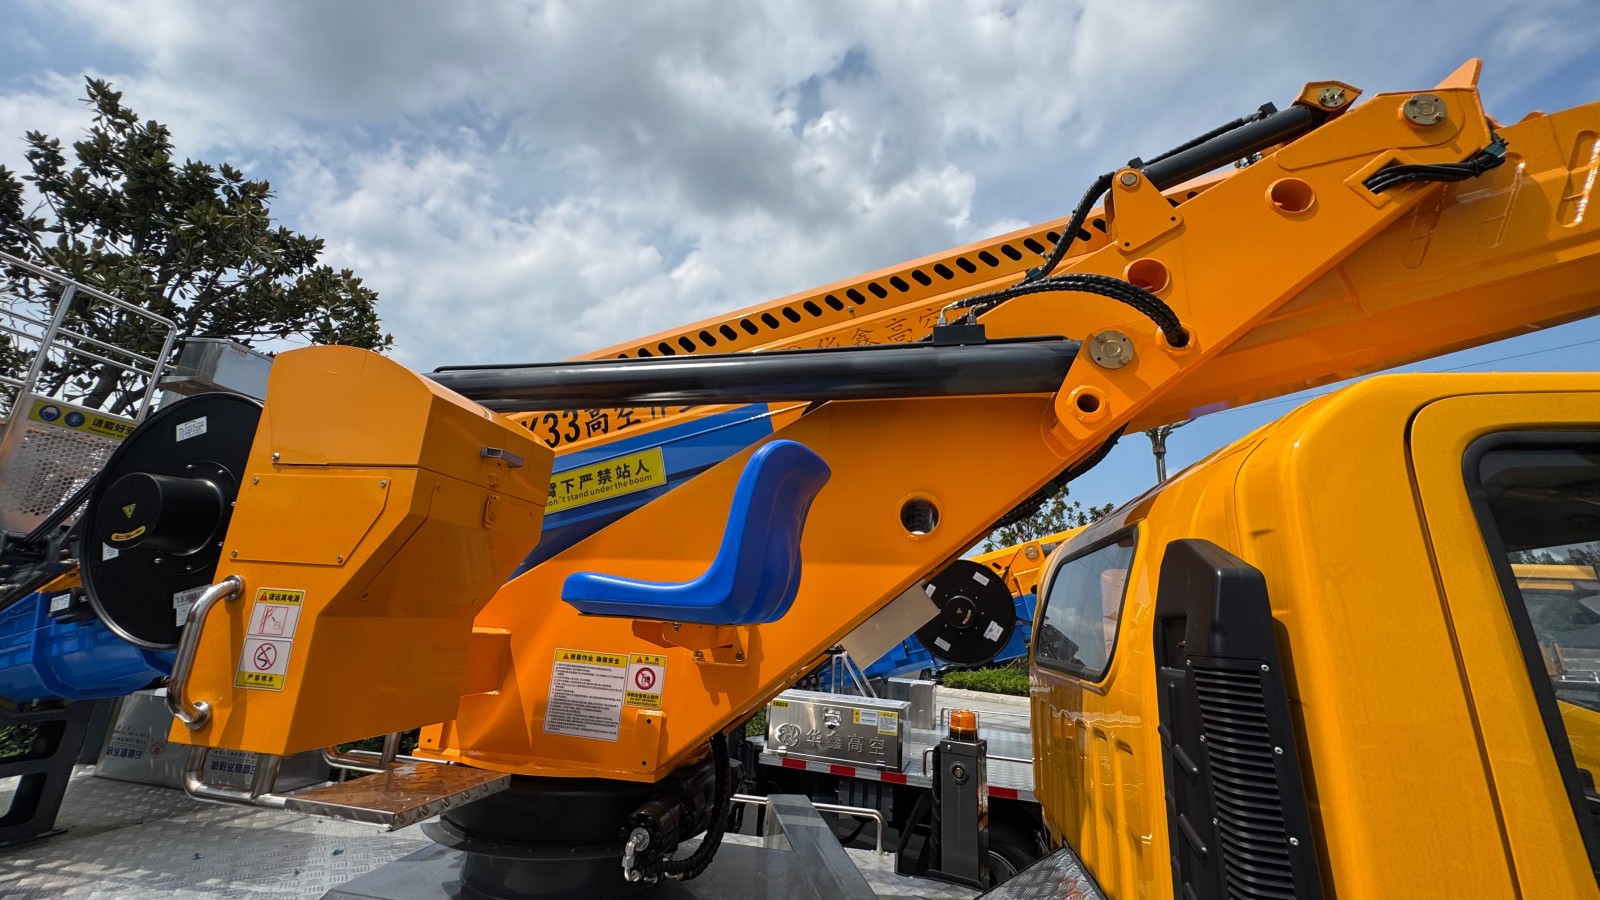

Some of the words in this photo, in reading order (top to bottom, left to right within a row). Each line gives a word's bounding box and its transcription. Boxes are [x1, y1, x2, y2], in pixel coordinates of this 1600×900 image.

[566, 489, 589, 502] stand
[589, 483, 613, 496] under
[613, 480, 628, 491] the
[628, 474, 652, 486] boom
[806, 728, 885, 755] 华鑫高空
